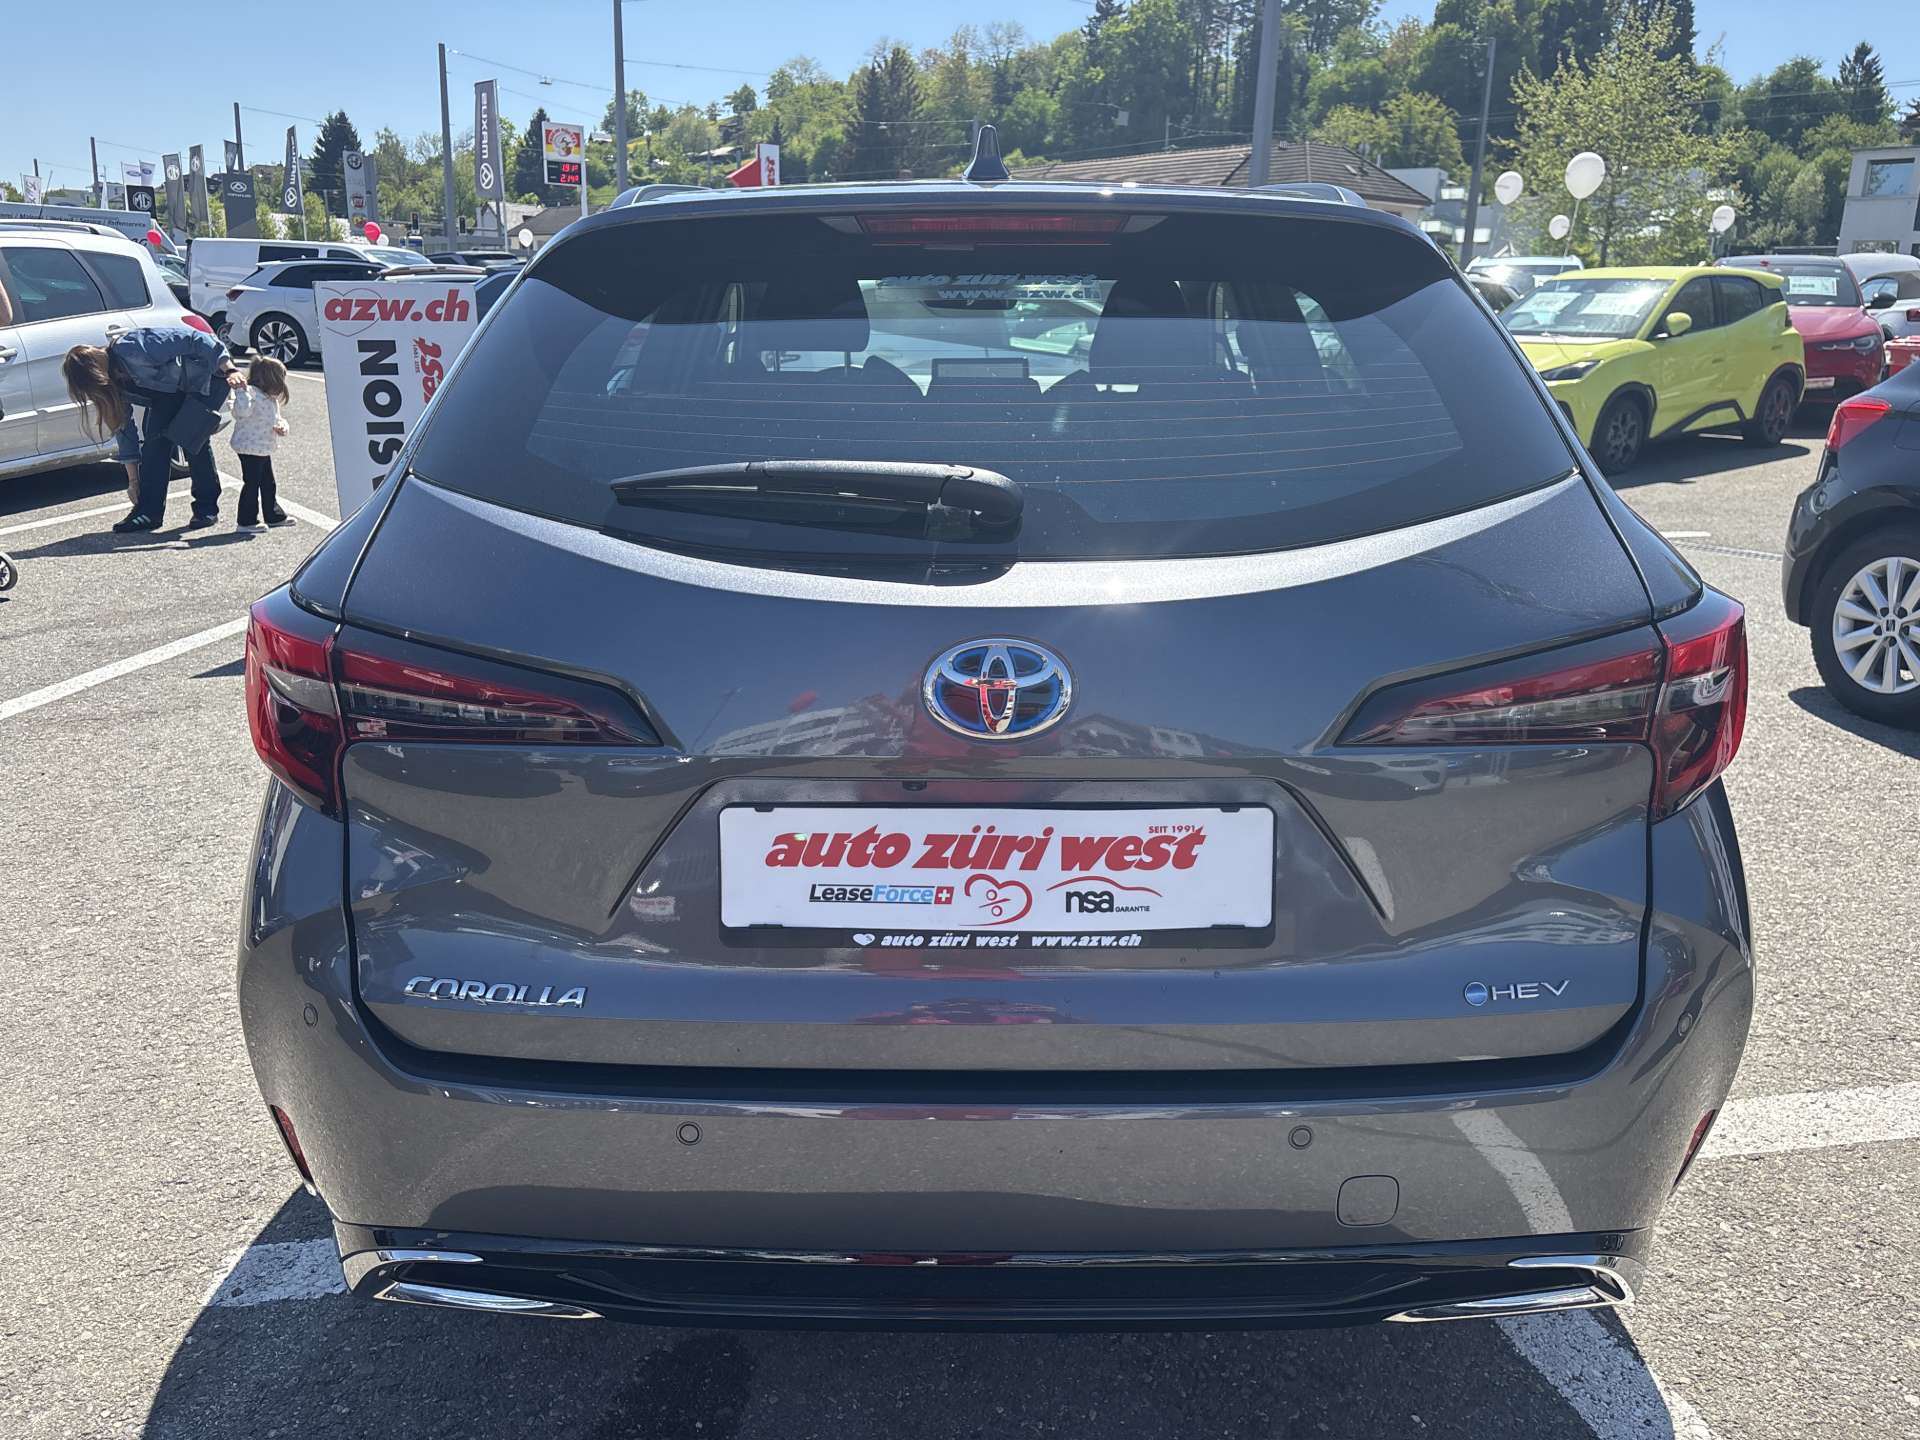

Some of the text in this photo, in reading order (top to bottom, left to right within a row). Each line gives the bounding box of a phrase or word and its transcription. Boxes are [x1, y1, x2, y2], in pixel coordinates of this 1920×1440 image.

[324, 289, 470, 322] azw.ch
[1148, 825, 1196, 834] SEIT 1991
[765, 824, 1207, 872] auto züri west
[809, 884, 934, 903] LeaseForce
[1065, 890, 1151, 913] nsa GARANTIE
[880, 933, 1142, 947] auto züri west www.azw.ch
[404, 976, 587, 1008] COROLLA
[1491, 980, 1571, 1001] HEV
